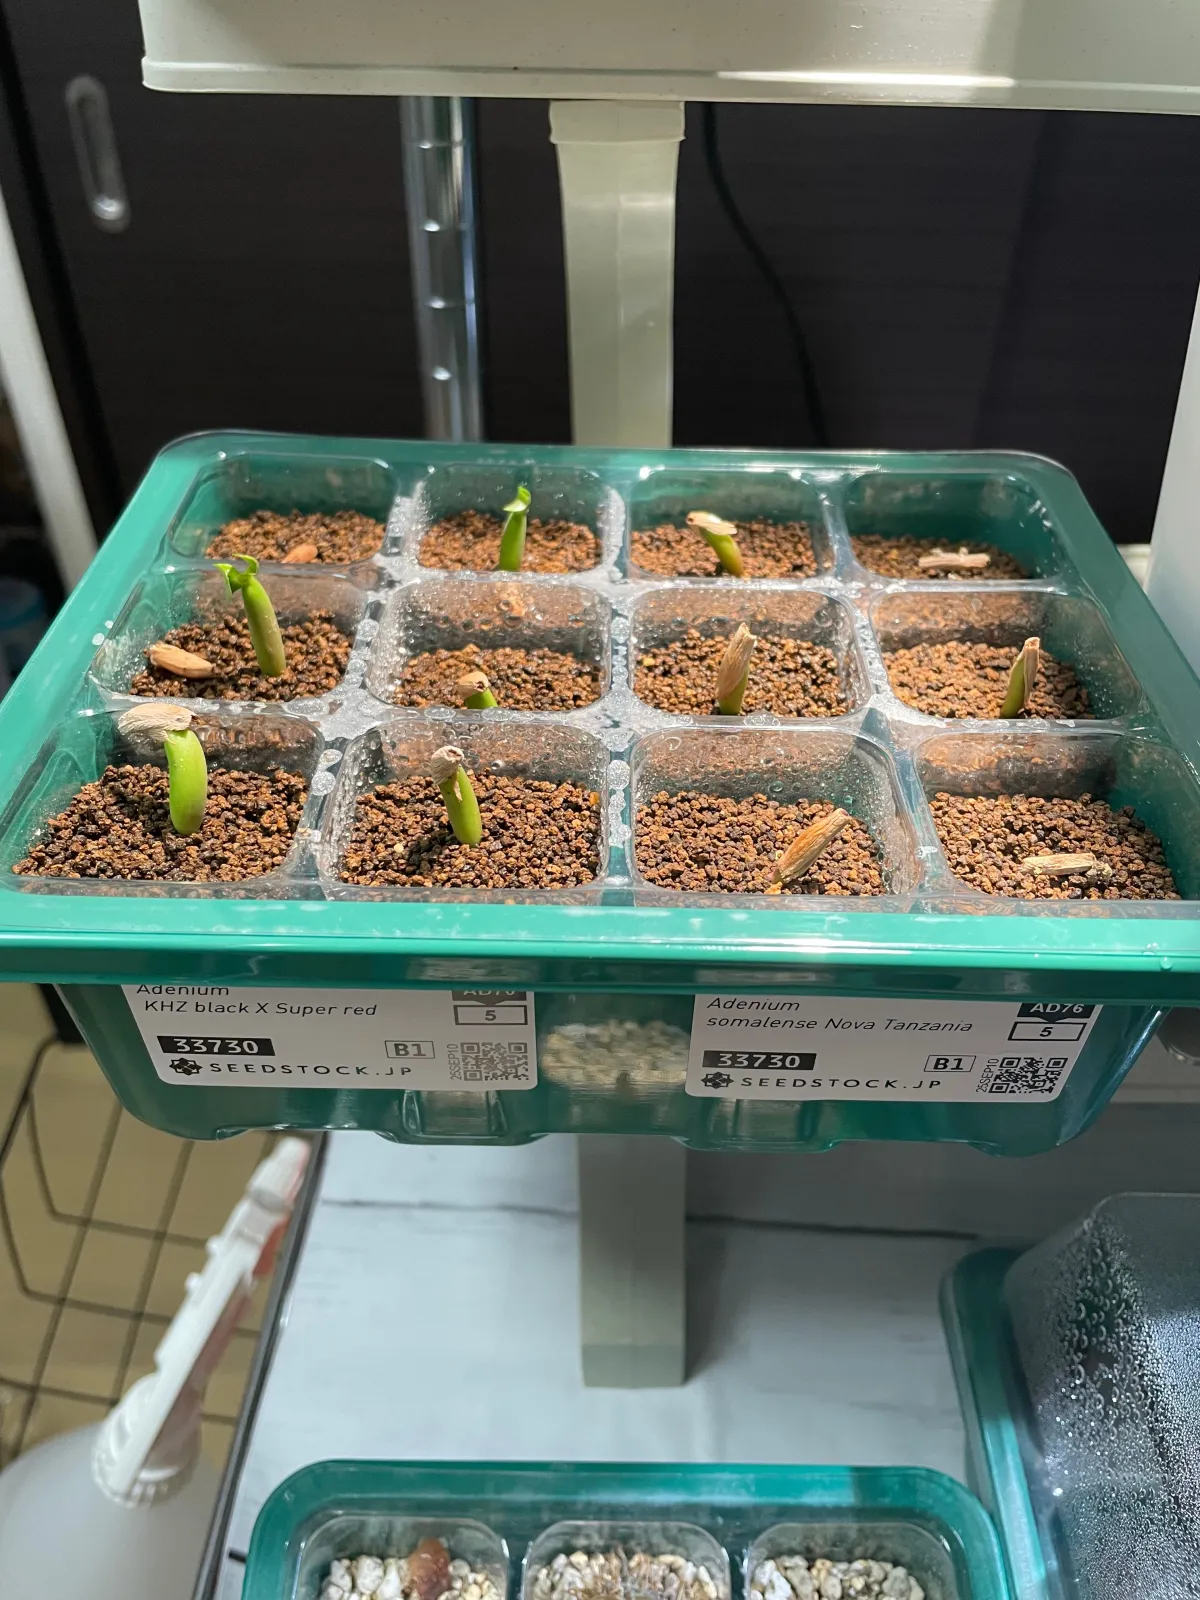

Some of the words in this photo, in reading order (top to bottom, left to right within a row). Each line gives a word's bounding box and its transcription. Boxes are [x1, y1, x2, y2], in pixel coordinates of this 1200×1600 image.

[136, 984, 229, 996] Adenium
[144, 1000, 188, 1013] KHZ
[195, 1002, 249, 1014] black
[255, 1002, 269, 1014] X
[275, 1003, 338, 1017] Super
[343, 1004, 377, 1016] red
[706, 997, 801, 1011] Adenium
[1029, 1003, 1083, 1014] AD76
[484, 1009, 497, 1022] 5
[706, 1016, 818, 1029] somalense
[824, 1018, 876, 1031] Nova
[883, 1018, 973, 1032] Tanzania
[1039, 1026, 1053, 1038] 5
[173, 1038, 259, 1054] 33730
[393, 1043, 427, 1057] B1
[717, 1053, 801, 1068] 33730
[933, 1057, 964, 1071] B1
[210, 1063, 412, 1076] SEEDSTOCK.JP
[975, 1058, 1000, 1093] 25SEP10
[740, 1077, 941, 1089] SEEDSTOCK.JP
